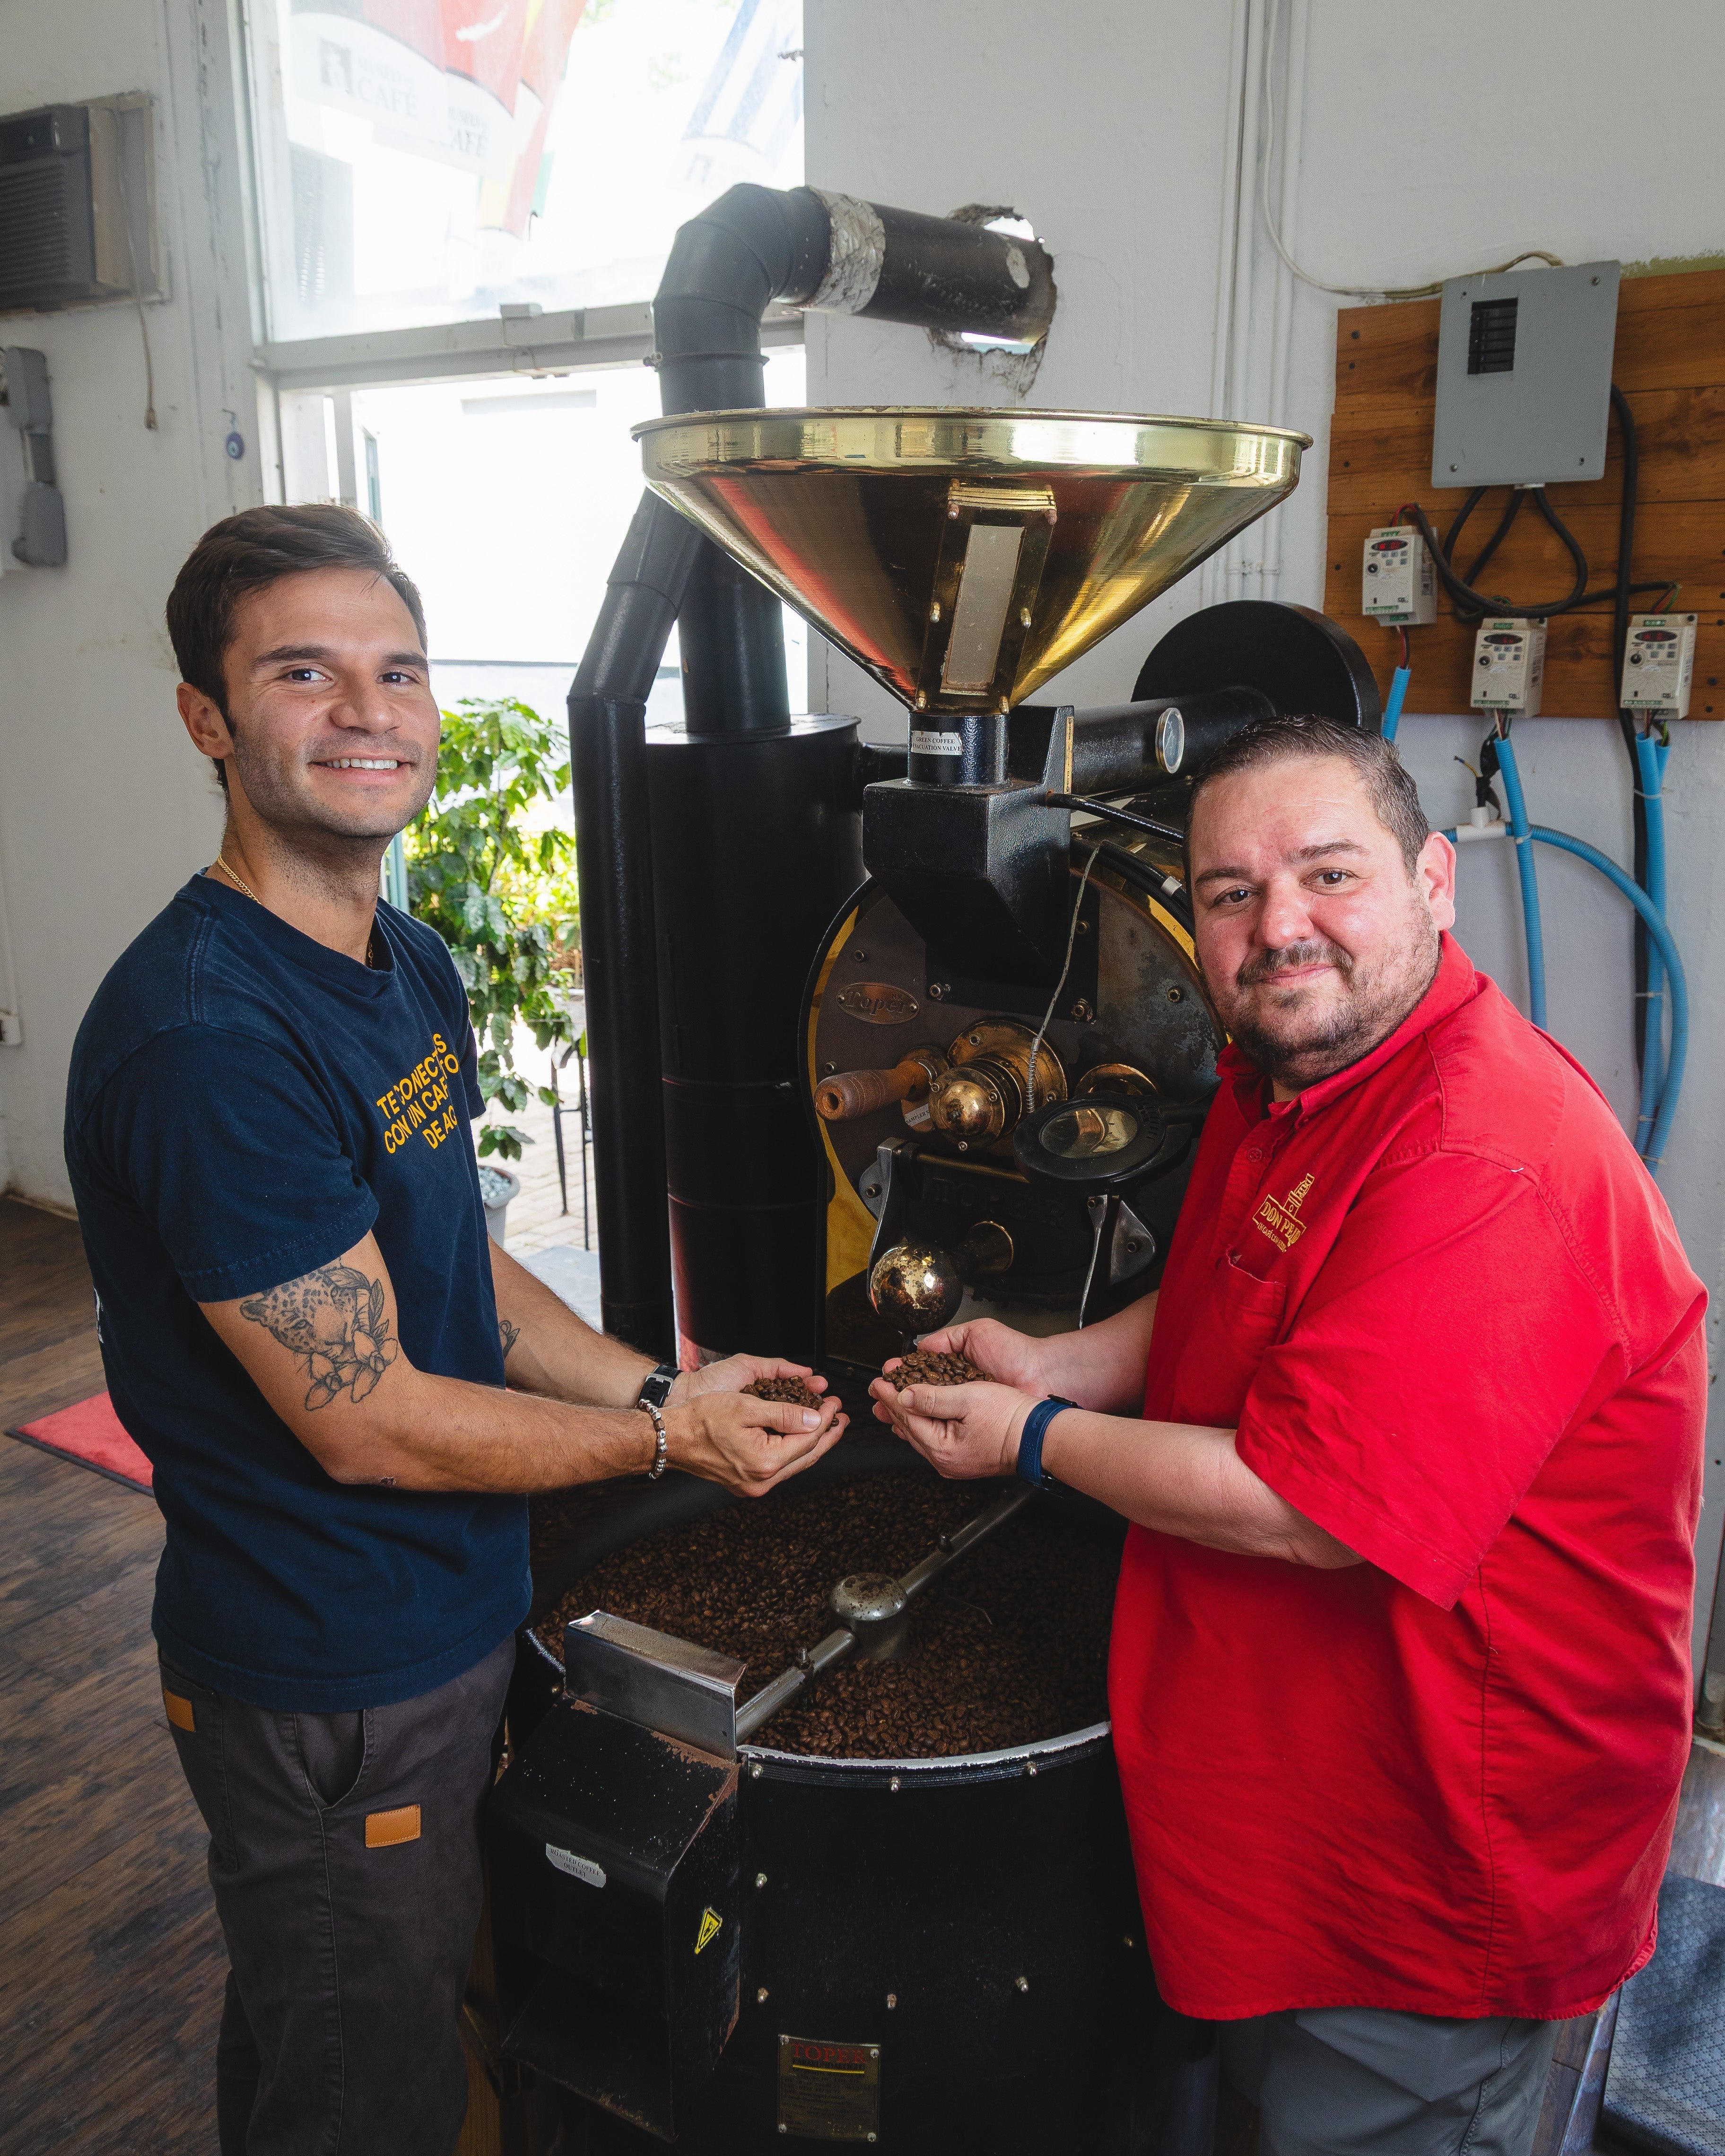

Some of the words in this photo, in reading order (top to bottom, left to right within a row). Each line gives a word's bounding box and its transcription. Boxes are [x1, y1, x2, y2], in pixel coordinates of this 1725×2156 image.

[449, 124, 488, 158] AFÉ
[845, 991, 908, 1016] Toper
[376, 1091, 400, 1119] TE
[906, 1112, 926, 1123] SAMPLER
[384, 1115, 412, 1154] CON
[408, 1100, 426, 1128] UN
[422, 1121, 446, 1149] DE
[1260, 1201, 1283, 1229] DON
[550, 1848, 576, 1865] ROASTED
[578, 1861, 601, 1877] COFFEE
[563, 1863, 586, 1878] OUTLET
[790, 2043, 867, 2064] TOPER
